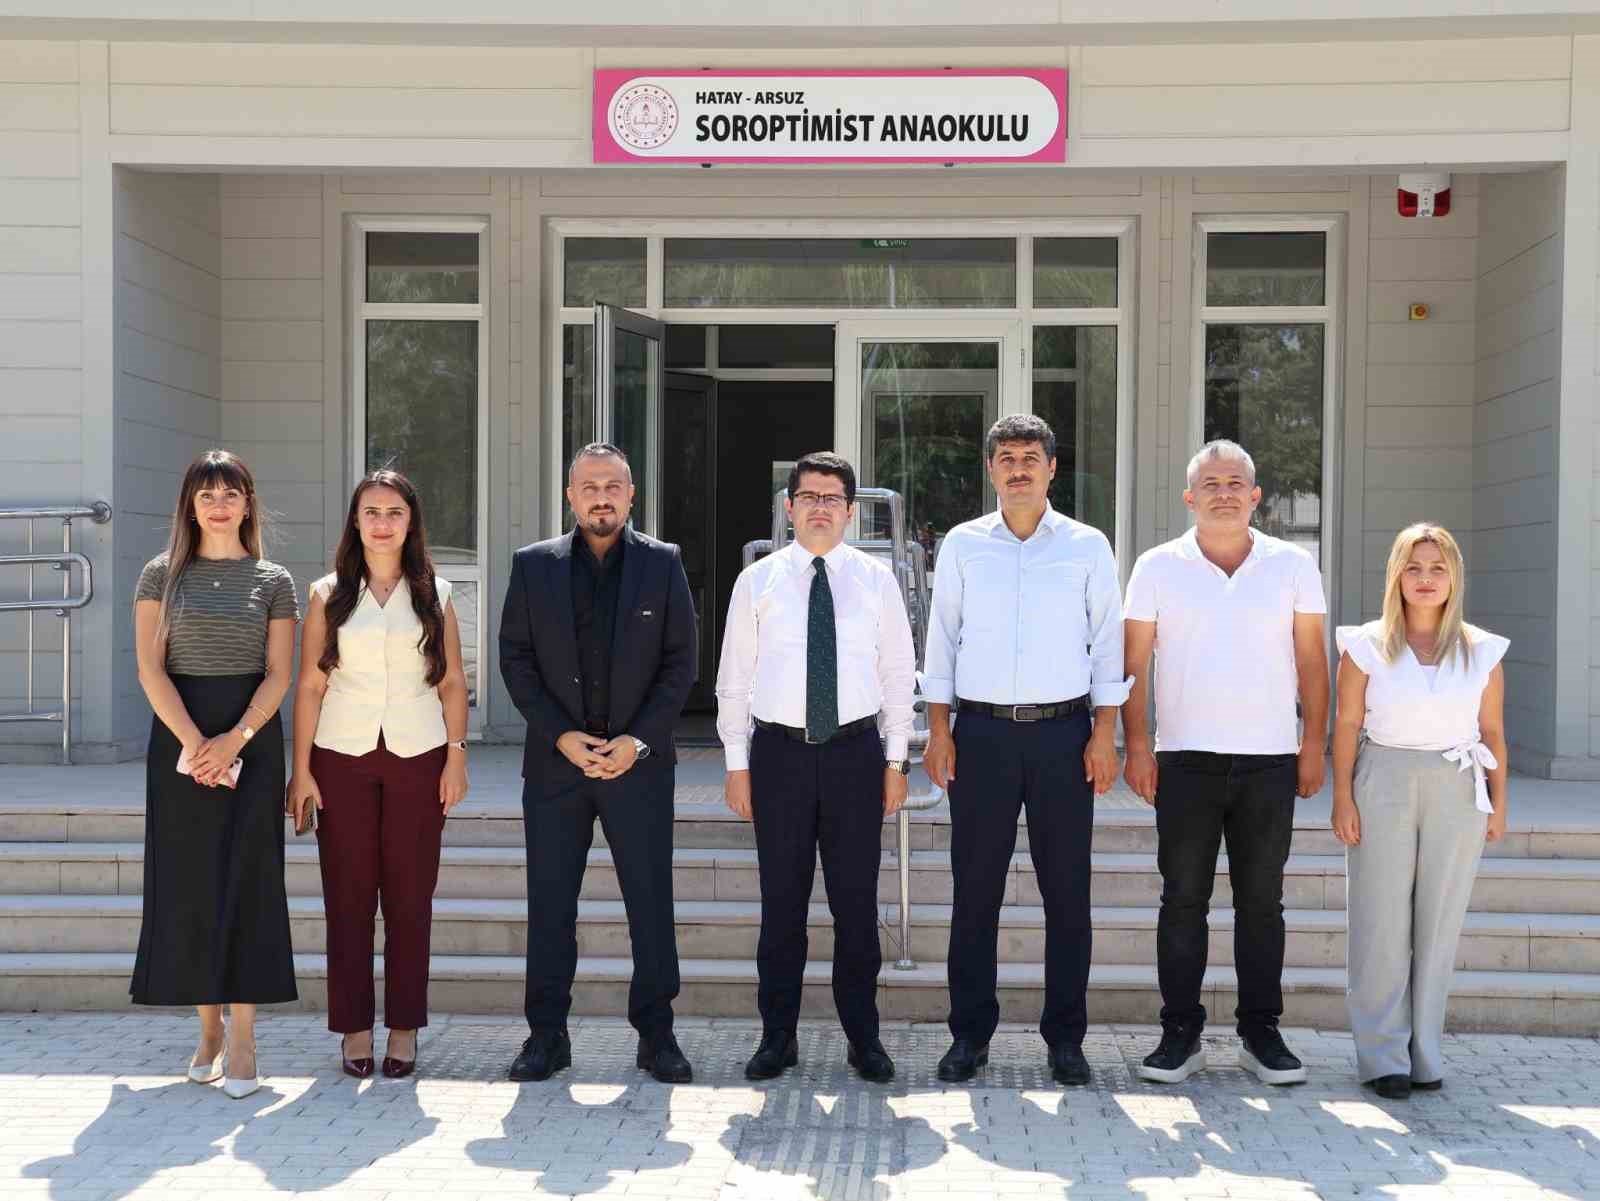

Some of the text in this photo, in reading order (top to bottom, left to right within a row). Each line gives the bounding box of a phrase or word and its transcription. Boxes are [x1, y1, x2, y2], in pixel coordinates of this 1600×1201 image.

[695, 91, 743, 105] HATAY
[754, 91, 805, 105] ARSUZ
[695, 107, 875, 142] SOROPTİMİST
[879, 114, 1029, 142] ANAOKULU
